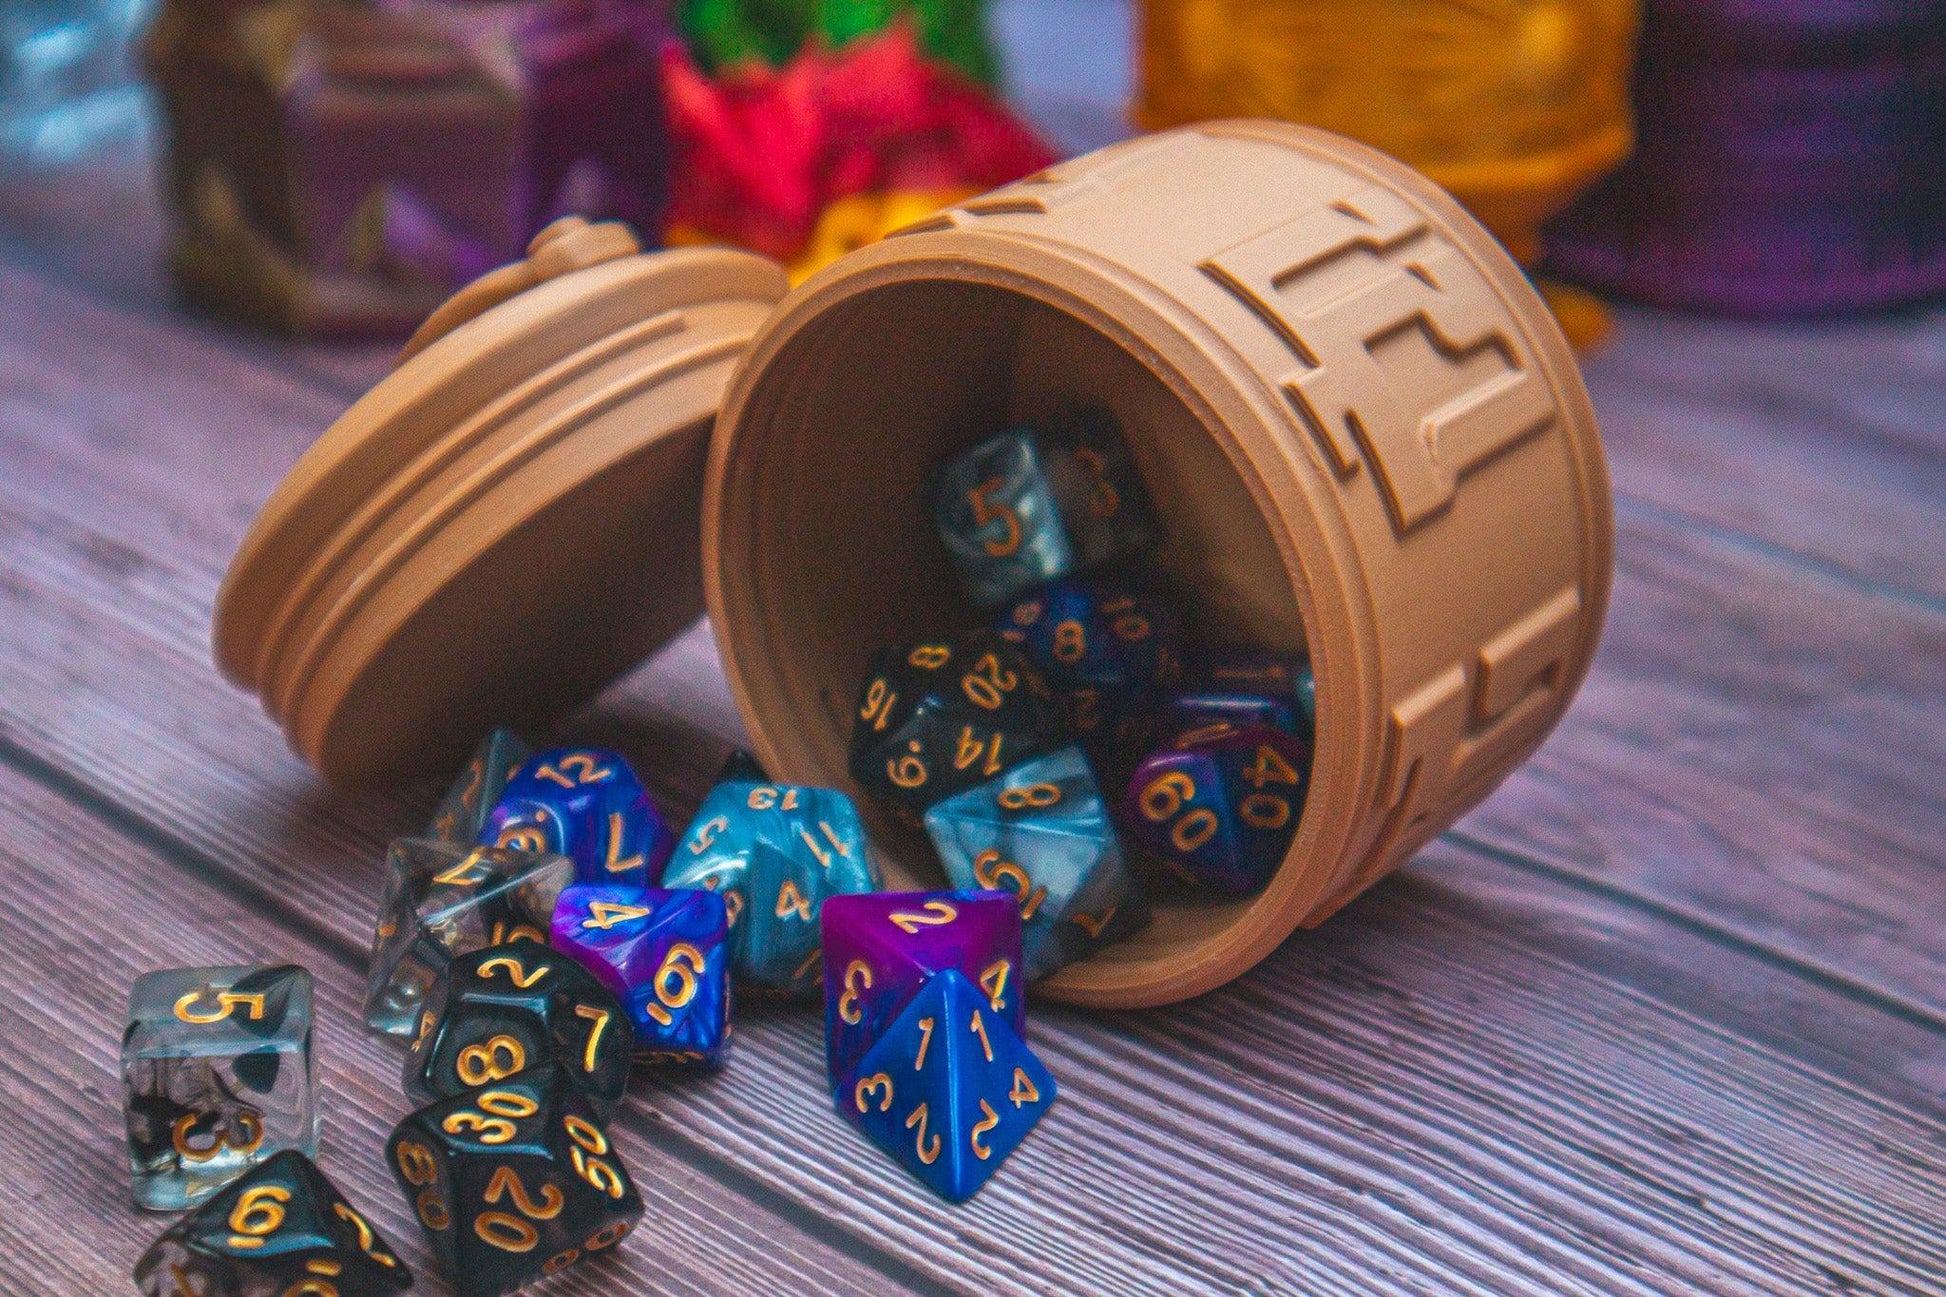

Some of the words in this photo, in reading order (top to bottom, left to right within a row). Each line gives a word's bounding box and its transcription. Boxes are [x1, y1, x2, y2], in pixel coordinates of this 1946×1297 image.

[967, 477, 1021, 557] 5
[908, 645, 951, 670] 8
[1053, 618, 1086, 665] 8
[860, 678, 897, 732] 16
[961, 653, 1018, 710] 20
[535, 755, 612, 789] 12
[953, 724, 1003, 777] 14
[747, 786, 799, 811] 13
[999, 783, 1061, 809] 8
[1140, 770, 1218, 852] 60
[1241, 744, 1300, 830] 40
[605, 811, 645, 873] 7
[689, 814, 728, 855] 5
[799, 821, 849, 868] 11
[582, 901, 650, 930] 4
[776, 879, 811, 922] 4
[889, 901, 957, 934] 2
[477, 958, 549, 989] 2
[840, 959, 872, 1025] 3
[980, 960, 1010, 1013] 4
[173, 991, 265, 1024] 5
[457, 1034, 525, 1087] 8
[574, 1003, 609, 1072] 7
[918, 1017, 934, 1071] 1
[970, 1009, 994, 1062] 1
[855, 1073, 894, 1113] 3
[1008, 1067, 1039, 1109] 4
[172, 1112, 264, 1163] 3
[443, 1091, 539, 1145] 30
[905, 1101, 941, 1164] 2
[971, 1098, 999, 1160] 2
[564, 1114, 623, 1199] 50
[473, 1166, 564, 1253] 20
